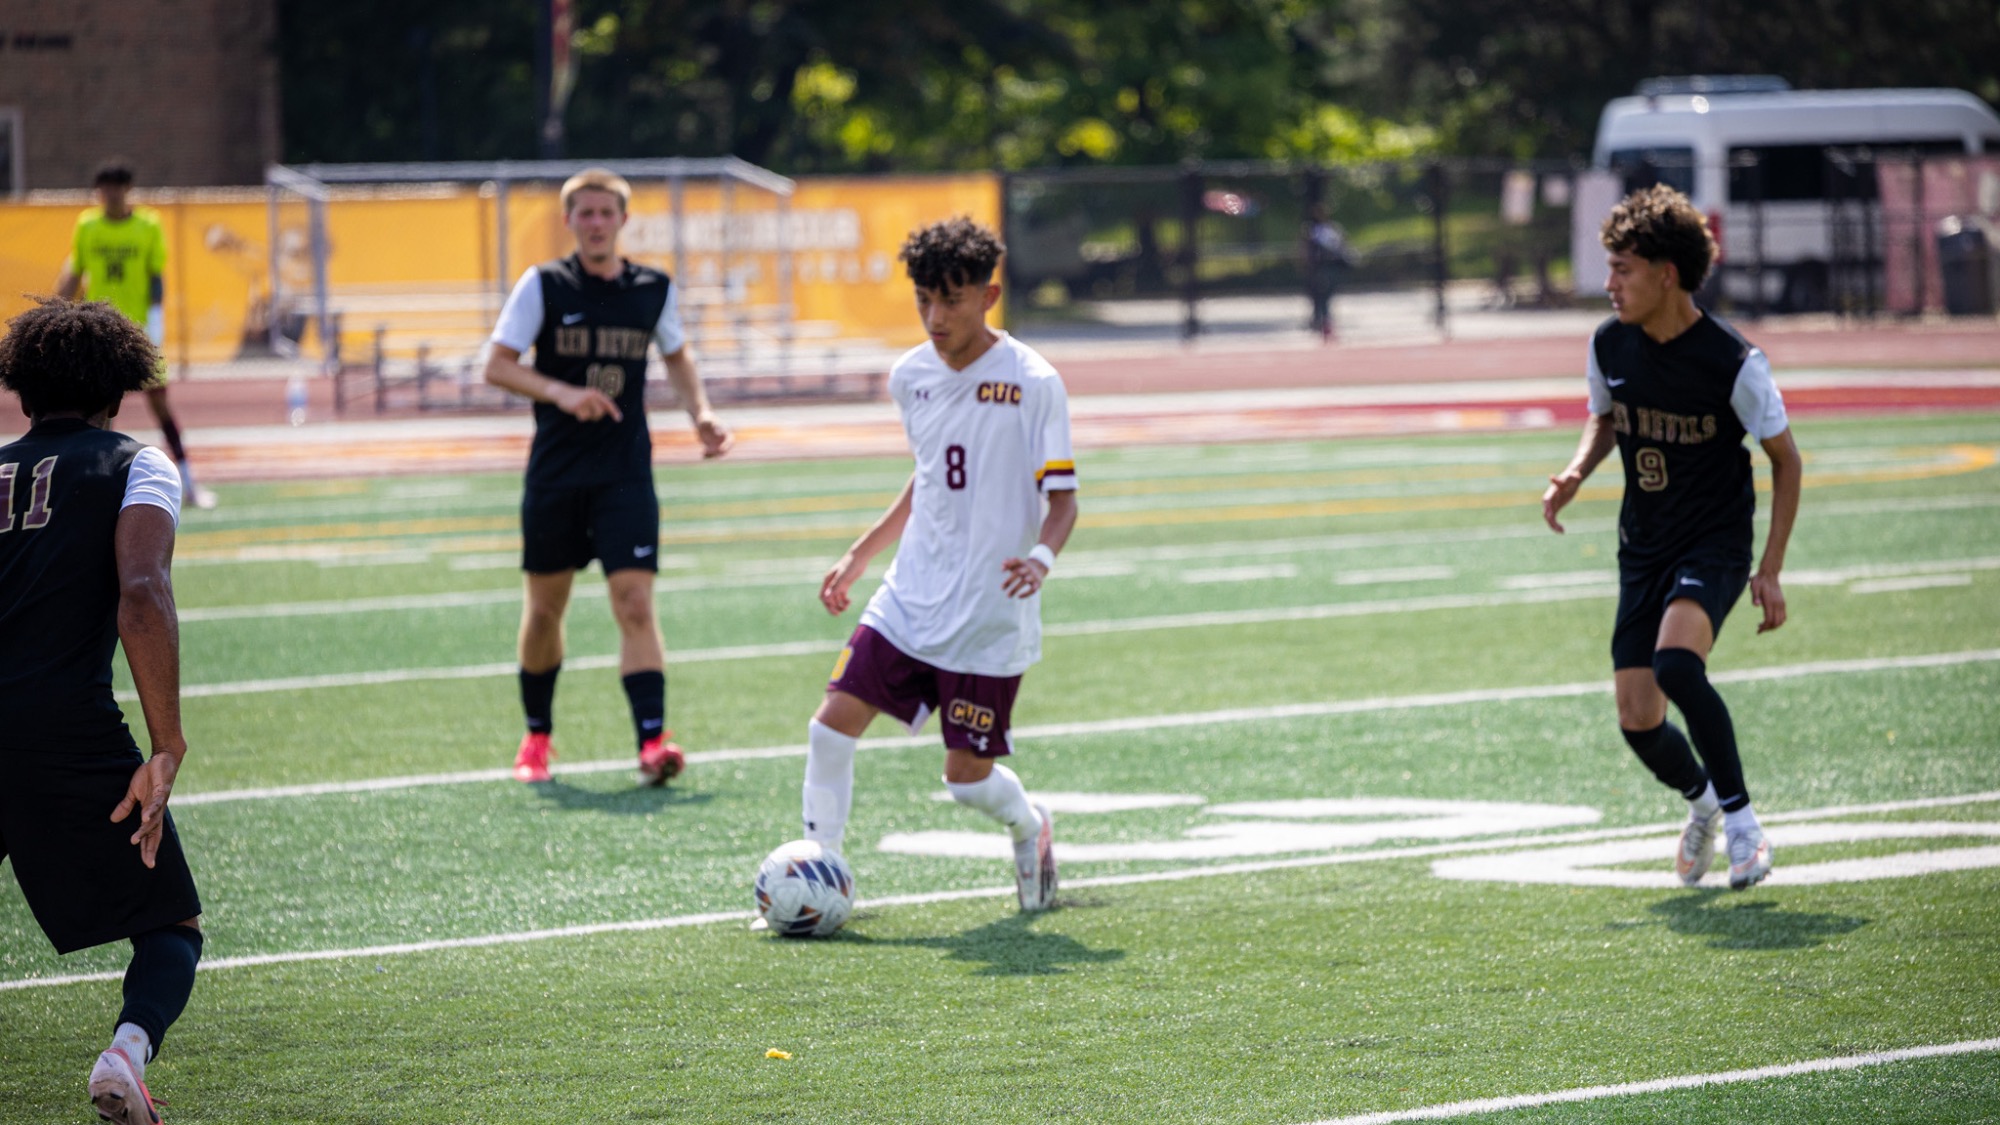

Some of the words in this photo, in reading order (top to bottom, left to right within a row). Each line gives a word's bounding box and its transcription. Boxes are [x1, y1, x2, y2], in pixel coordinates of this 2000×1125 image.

[596, 325, 650, 361] DEVIL
[976, 382, 1022, 406] CUC
[1636, 407, 1717, 445] DEVILS
[946, 445, 966, 490] 8
[1635, 447, 1669, 492] 9
[948, 699, 996, 733] CUC
